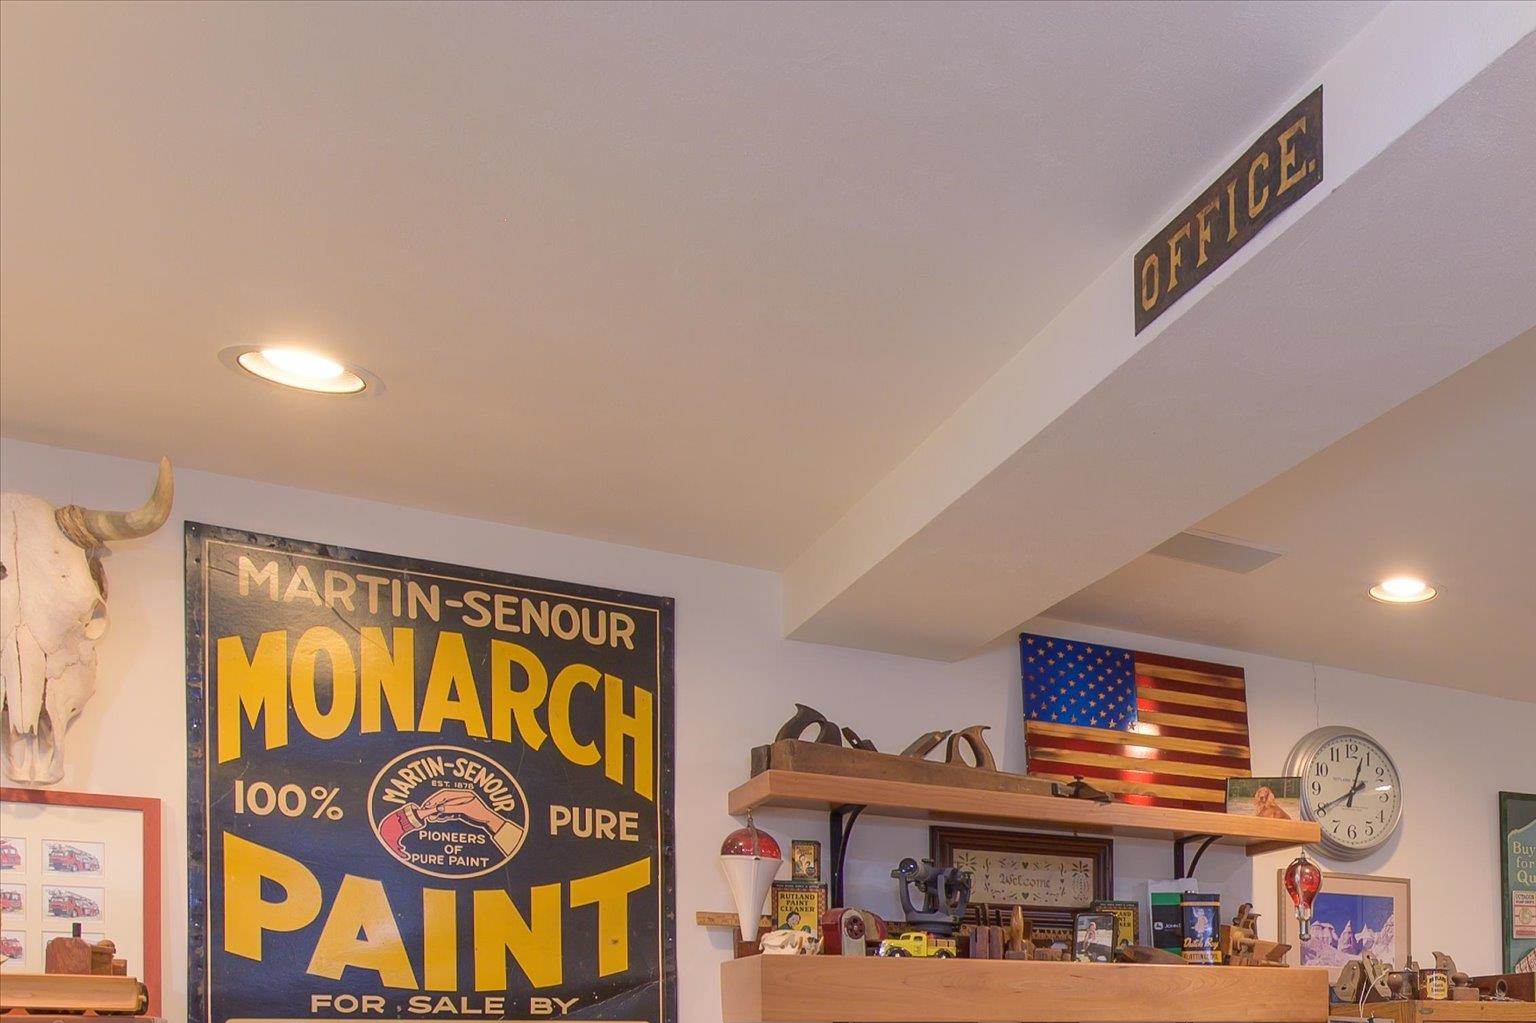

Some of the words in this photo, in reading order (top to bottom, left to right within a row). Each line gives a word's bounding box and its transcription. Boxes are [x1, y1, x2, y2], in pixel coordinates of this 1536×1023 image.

[238, 556, 635, 650] MARTIN-SENOUR
[216, 625, 654, 802] MONARCH
[1330, 747, 1340, 762] 11
[1345, 744, 1359, 760] 12
[1365, 752, 1371, 766] 1
[1316, 762, 1329, 777] 10
[1375, 766, 1385, 783] 2
[382, 755, 516, 812] MARTIN-SENOUR
[454, 782, 475, 790] 1878
[1312, 781, 1322, 796] 9
[235, 779, 343, 820] 100%
[1316, 802, 1327, 817] 8
[550, 805, 639, 842] PURE
[1332, 819, 1342, 834] 7
[1364, 822, 1374, 836] 5
[419, 831, 486, 844] PIONEERS
[1347, 825, 1357, 840] 6
[444, 845, 463, 854] OF
[1513, 841, 1536, 857] Buy
[412, 854, 444, 865] PURE
[449, 856, 490, 867] PAINT
[1516, 856, 1535, 868] for
[223, 831, 651, 992] PAINT
[311, 994, 385, 1014] FOR
[408, 995, 505, 1015] SALE
[530, 997, 580, 1015] BY
